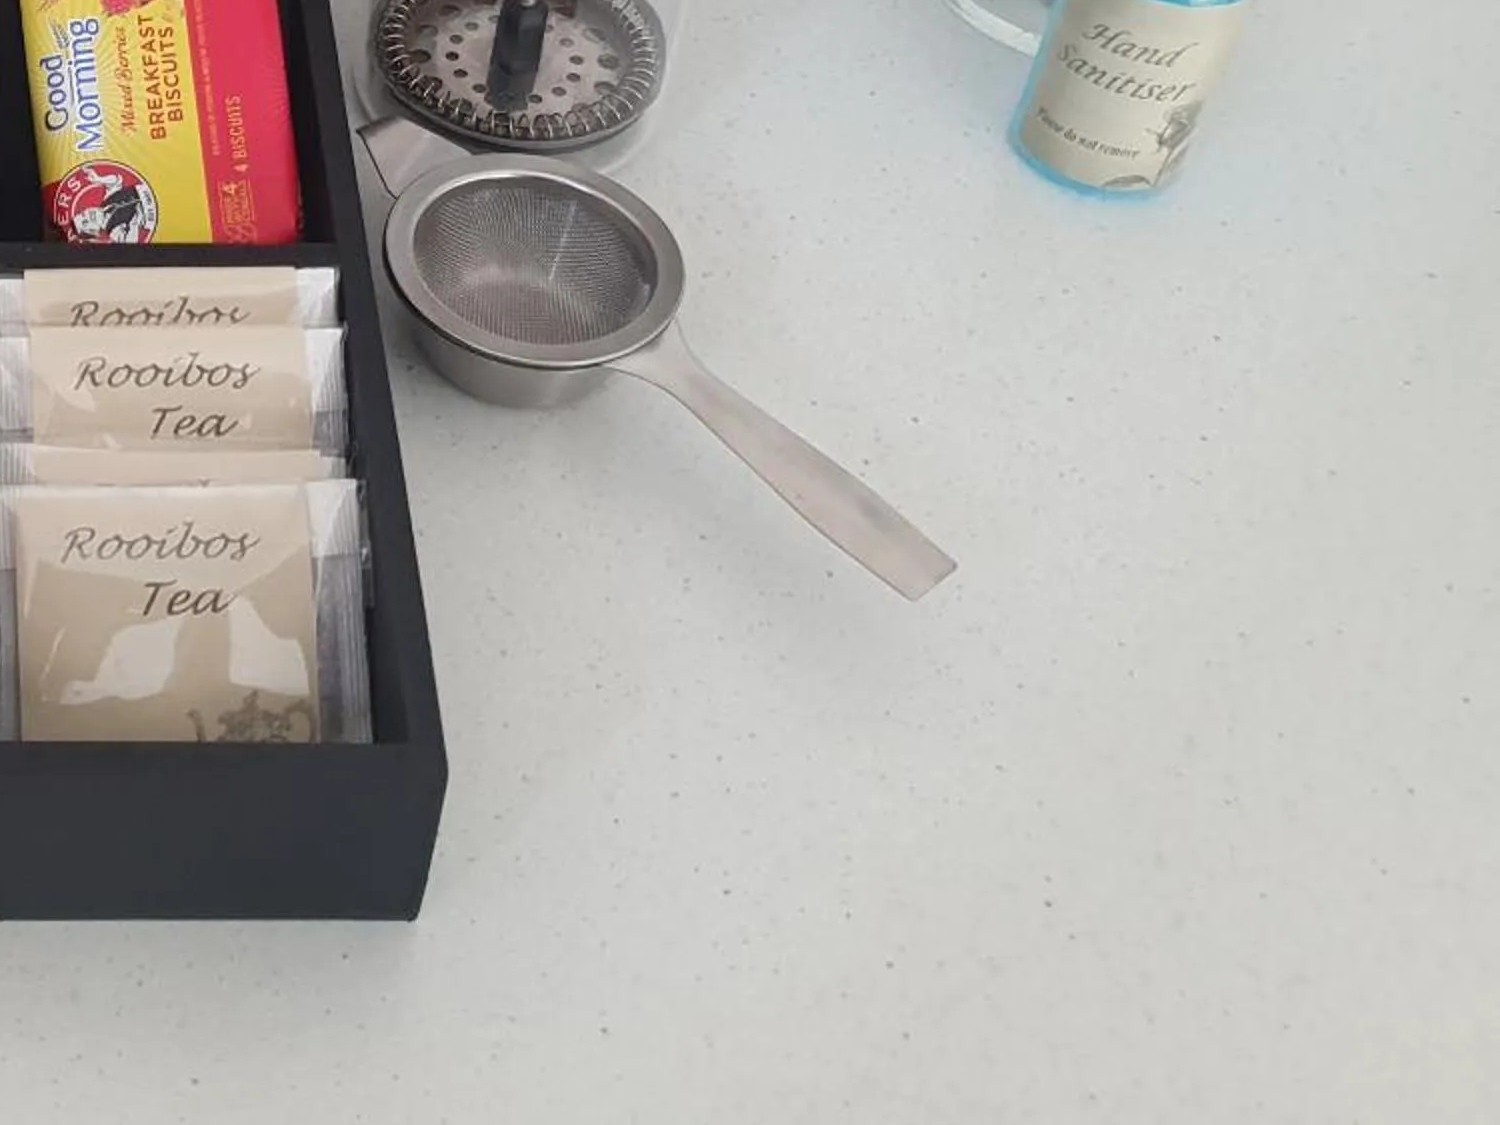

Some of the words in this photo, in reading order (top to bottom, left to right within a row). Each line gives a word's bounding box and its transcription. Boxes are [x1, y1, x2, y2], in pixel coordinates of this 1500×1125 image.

[158, 26, 184, 122] BISCUITS
[1057, 43, 1197, 103] Sanitiser
[1081, 23, 1200, 68] Hand
[40, 55, 69, 132] Good
[70, 17, 104, 151] Morning
[138, 14, 167, 140] BREAKFAST
[225, 95, 248, 160] BISCUITS
[73, 352, 261, 392] Rooibos
[149, 404, 238, 441] Tea
[60, 520, 261, 565] Rooibos
[138, 579, 238, 617] Tea
